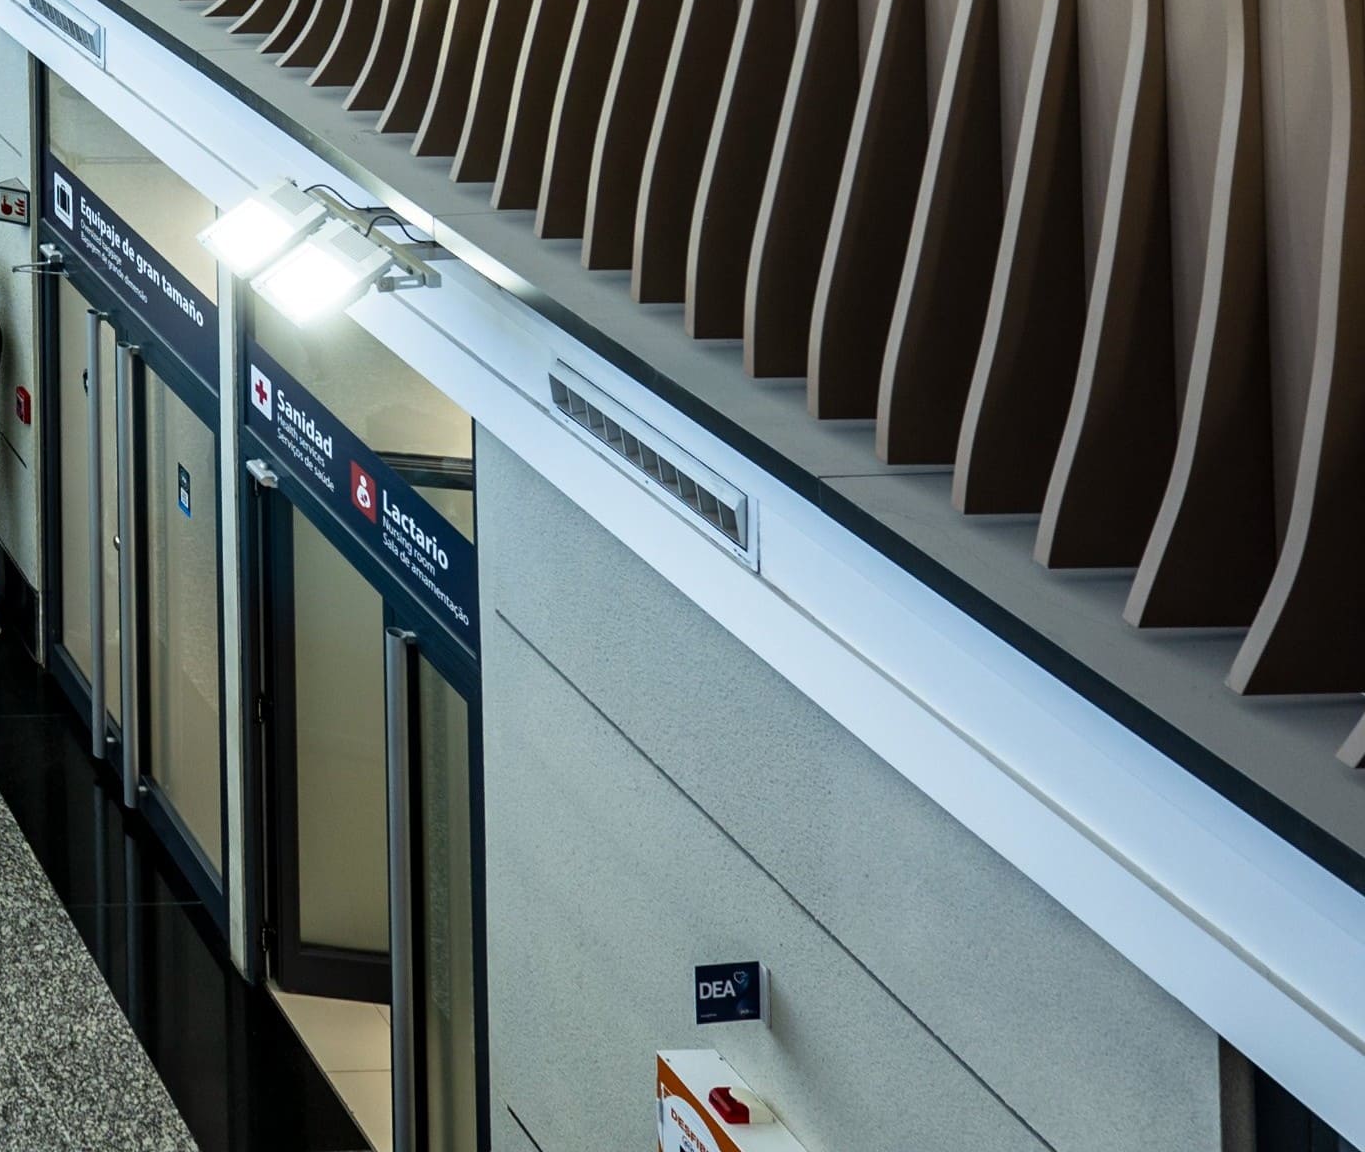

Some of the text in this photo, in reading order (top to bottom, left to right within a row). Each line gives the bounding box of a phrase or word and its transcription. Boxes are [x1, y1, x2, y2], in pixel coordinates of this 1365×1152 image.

[80, 195, 204, 328] Equipaje de gran tamaño
[277, 389, 333, 460] Sanidad
[277, 414, 325, 468] Health services
[277, 427, 335, 493] Serviços de saúde
[382, 489, 449, 571] Lactario
[382, 516, 436, 577] Nursing room
[382, 532, 470, 627] Sala de amamentação
[699, 979, 736, 1000] DEA
[670, 1107, 710, 1152] DESFIB
